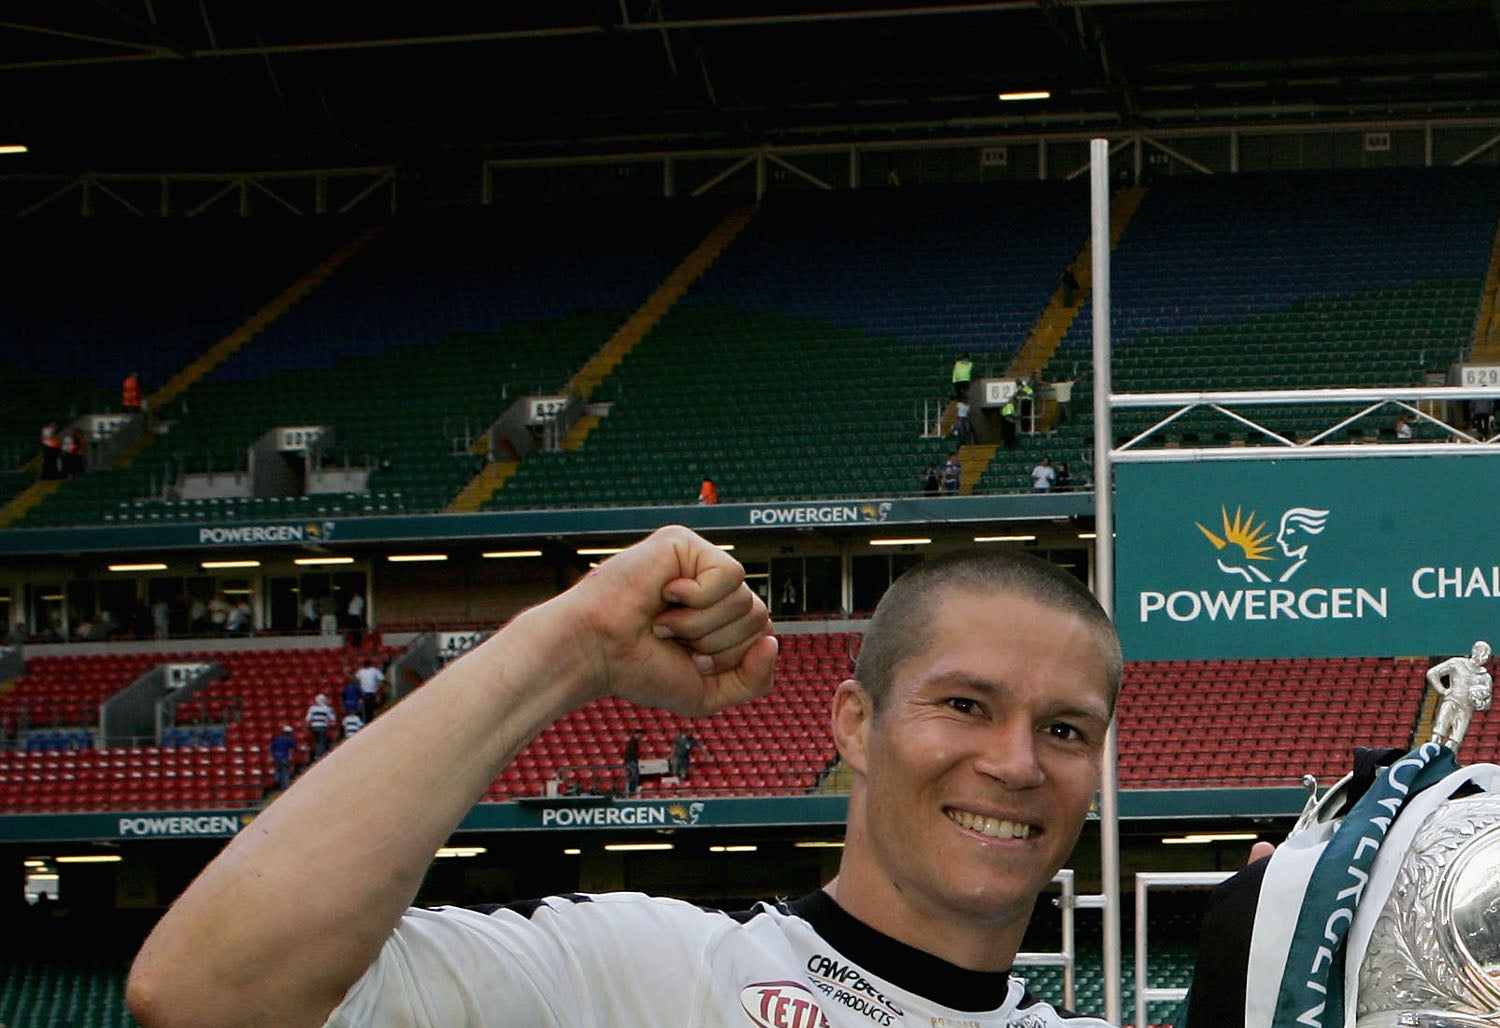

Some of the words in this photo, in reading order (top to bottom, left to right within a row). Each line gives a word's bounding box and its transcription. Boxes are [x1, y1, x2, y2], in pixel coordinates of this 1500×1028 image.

[1468, 371, 1500, 386] 629
[991, 384, 1012, 399] 62
[750, 506, 857, 524] POWERGEN
[200, 526, 301, 544] POWERGEN
[1139, 587, 1388, 622] POWERGEN
[119, 816, 239, 835] POWERGEN
[542, 806, 665, 828] POWERGEN
[833, 988, 897, 1028] PRODUCTS
